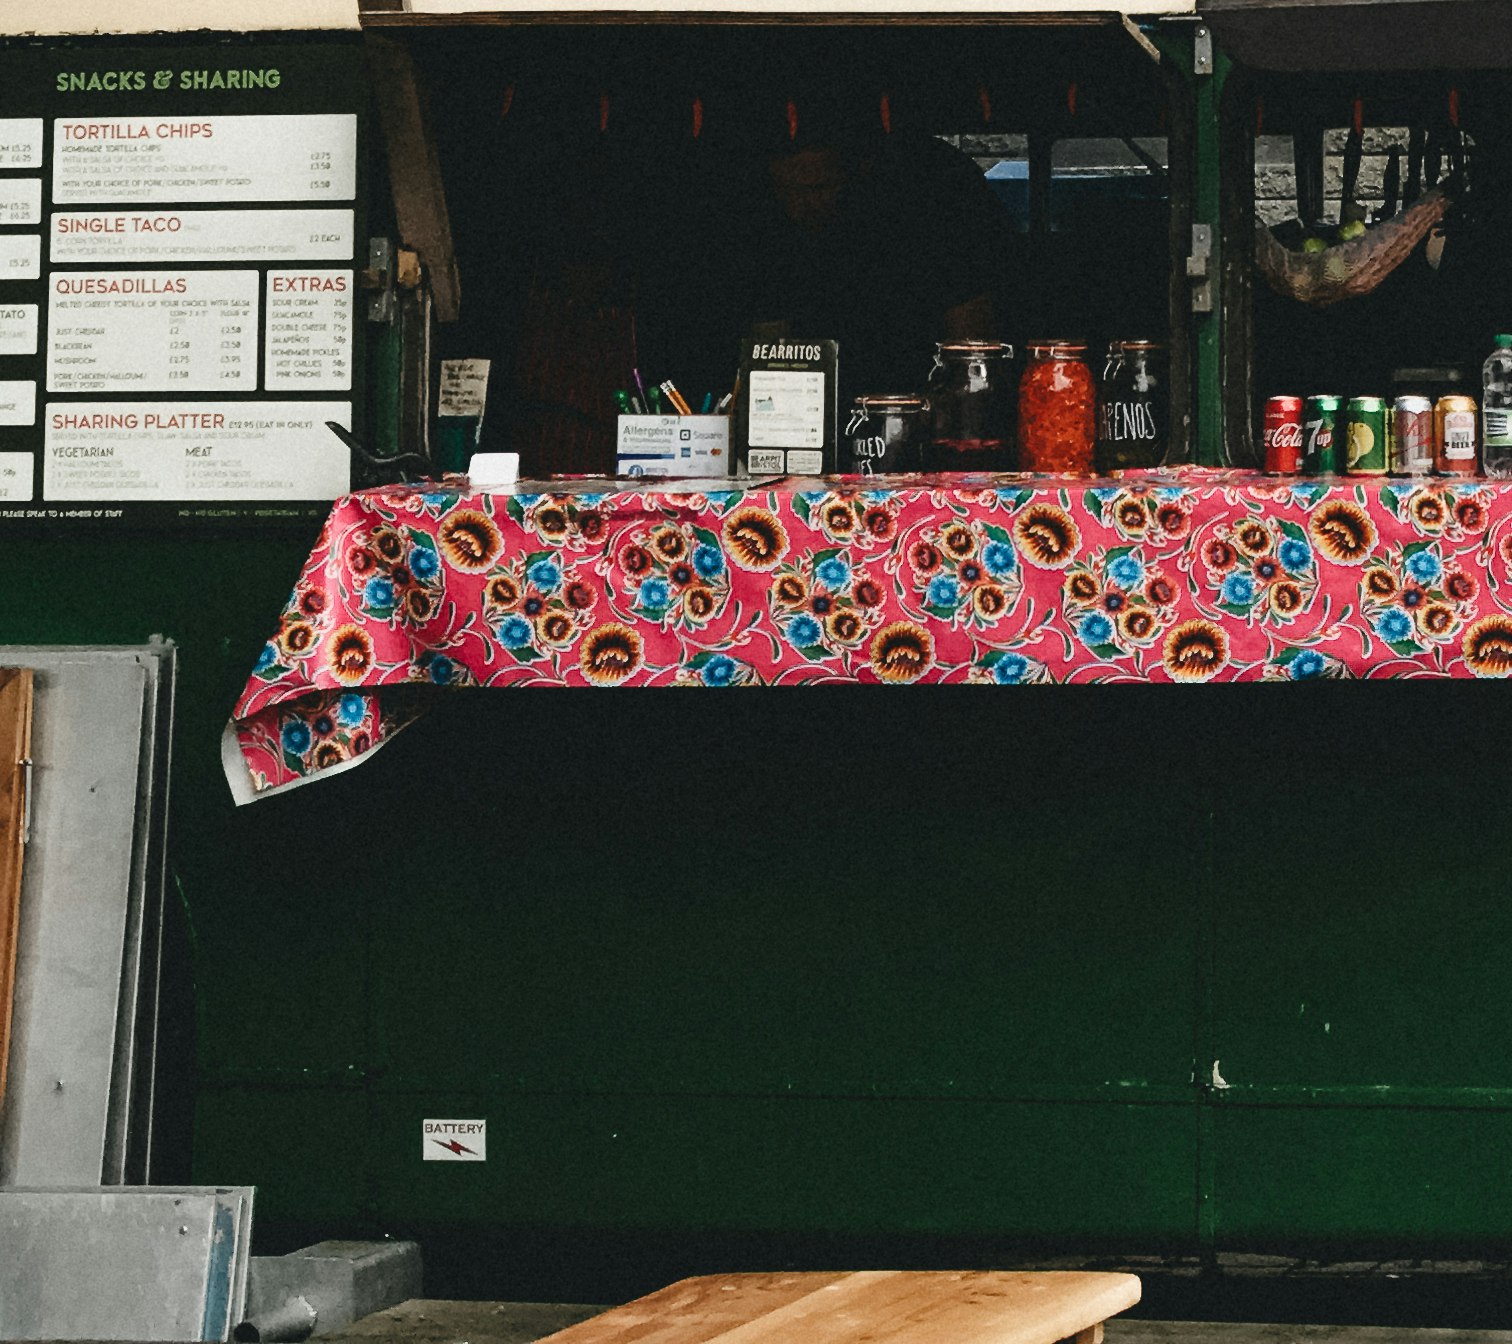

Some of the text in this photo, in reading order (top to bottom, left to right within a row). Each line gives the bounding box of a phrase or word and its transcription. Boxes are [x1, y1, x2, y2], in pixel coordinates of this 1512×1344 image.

[56, 68, 281, 92] SNACKS & SHARING
[62, 122, 213, 140] TORTILLA CHIPS
[58, 218, 125, 233] SINGLE
[131, 217, 182, 232] TACO
[320, 233, 341, 242] EACH
[56, 278, 188, 294] QUESADILLAS
[273, 277, 347, 292] EXTRAS
[752, 344, 822, 361] BEARRITOS
[52, 414, 139, 429] SHARING
[144, 413, 225, 429] PLATTER
[623, 425, 673, 437] Allergens
[52, 446, 115, 458] VEGETARIAN
[185, 446, 213, 458] MEAT
[424, 1123, 484, 1134] BATTERY
